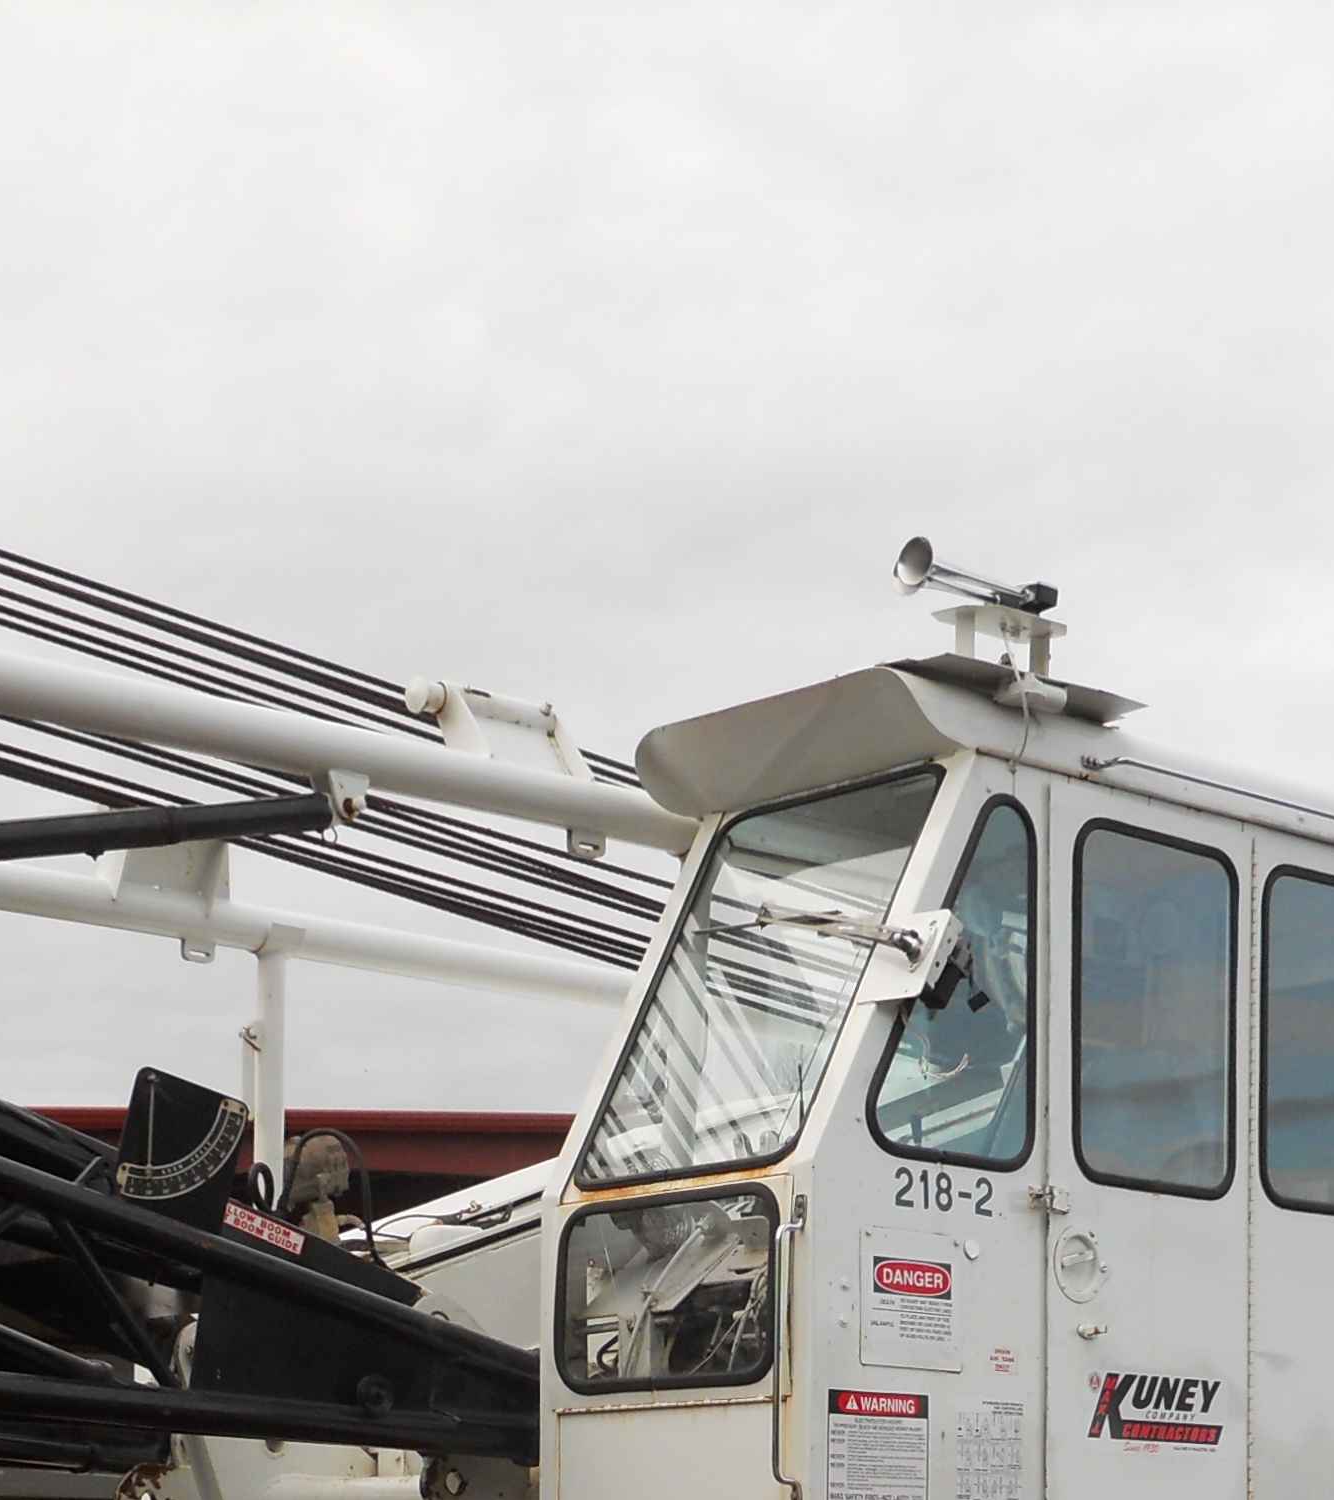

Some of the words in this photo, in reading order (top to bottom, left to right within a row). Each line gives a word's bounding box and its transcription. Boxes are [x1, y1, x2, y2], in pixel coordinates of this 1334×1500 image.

[895, 1167, 993, 1217] 218-2
[882, 1267, 944, 1289] DANGER
[860, 1396, 916, 1414] WARNING
[1087, 1372, 1221, 1439] KUNEY
[1145, 1410, 1196, 1421] COMPANY
[1122, 1422, 1218, 1443] CONTRACTORS
